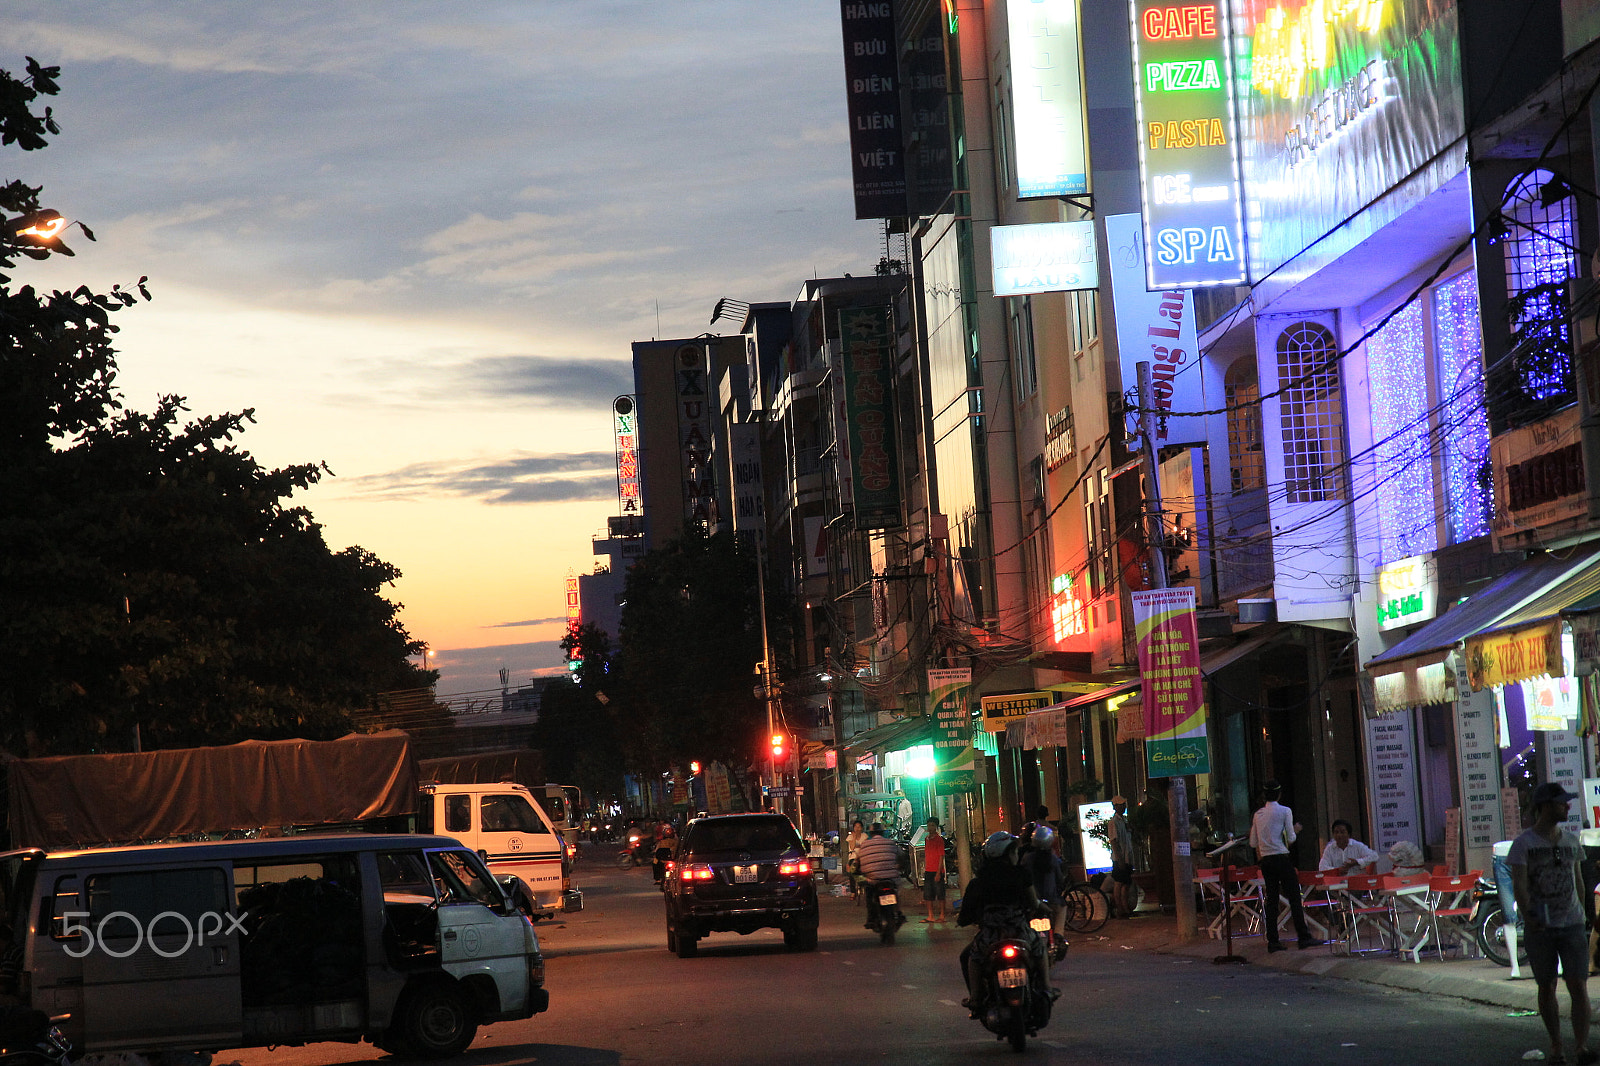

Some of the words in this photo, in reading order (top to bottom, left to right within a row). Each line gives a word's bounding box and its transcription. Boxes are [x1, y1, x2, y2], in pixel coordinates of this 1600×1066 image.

[1143, 5, 1217, 40] CAFE
[1146, 59, 1221, 93] PIZZA
[857, 111, 895, 130] LIÊN
[1148, 118, 1226, 150] PASTA
[859, 148, 897, 169] VIỆT
[1153, 174, 1191, 205] ICE
[1157, 225, 1235, 265] SPA
[1065, 272, 1081, 285] 3
[986, 699, 1038, 710] WESTERN
[1003, 707, 1038, 716] UNION
[1175, 705, 1186, 714] XE
[947, 730, 958, 738] KHI
